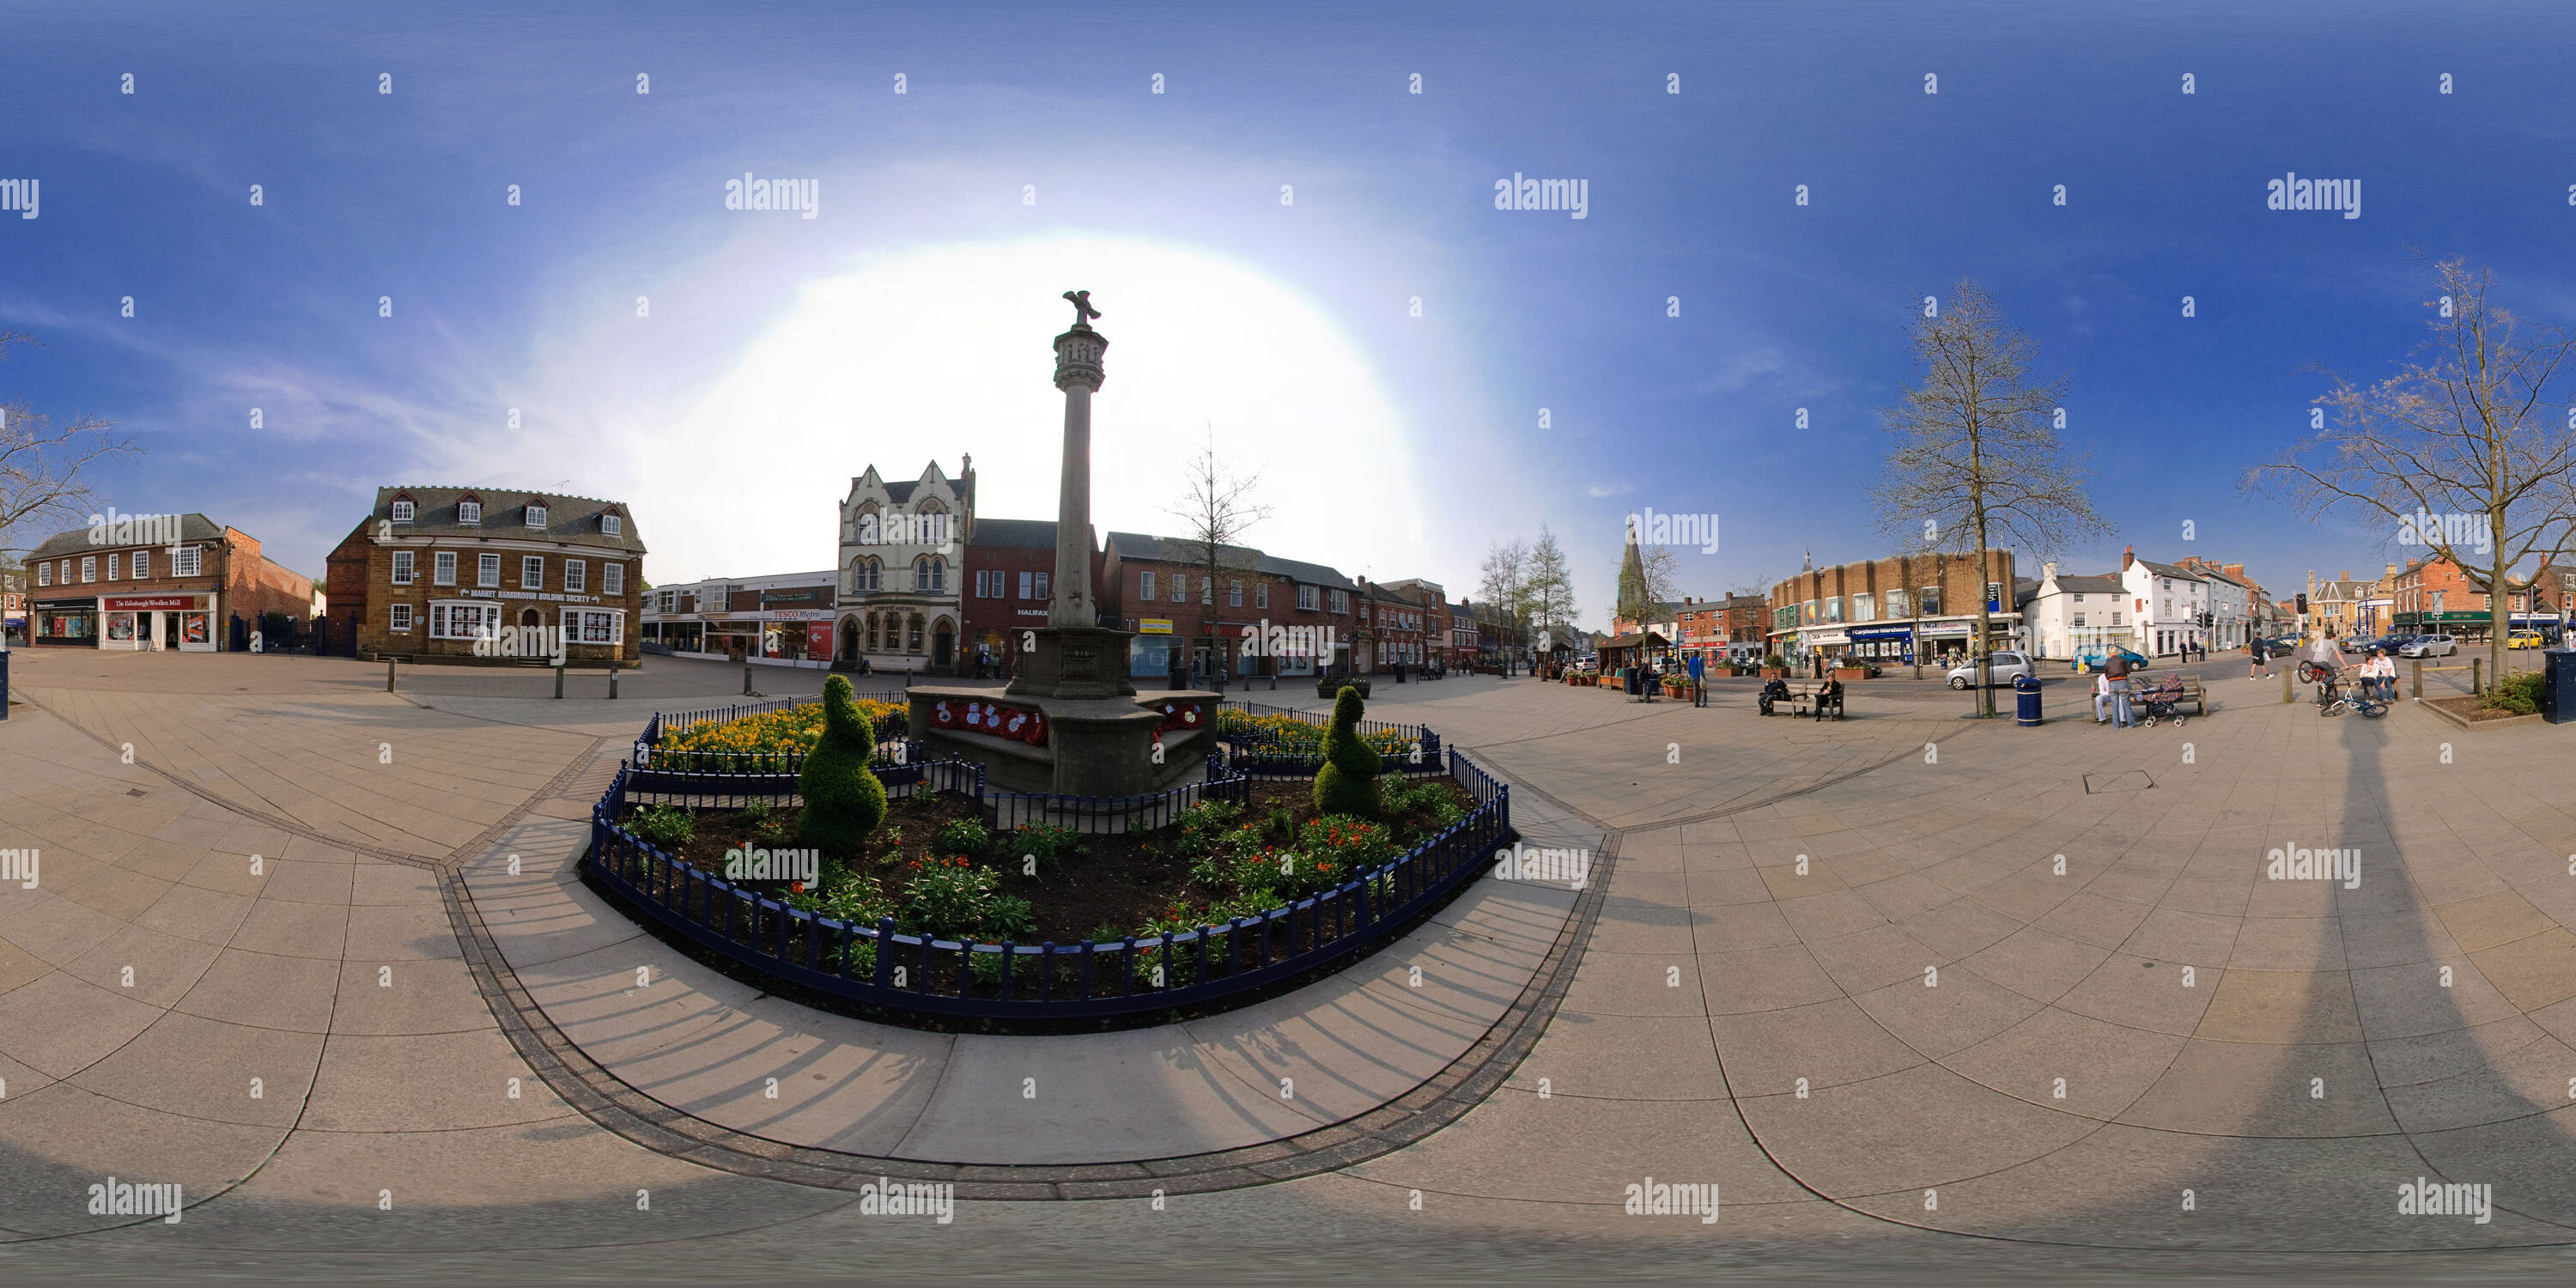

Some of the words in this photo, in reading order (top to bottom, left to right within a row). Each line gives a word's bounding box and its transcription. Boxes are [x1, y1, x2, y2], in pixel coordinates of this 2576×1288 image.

[471, 589, 496, 598] MARKET
[498, 591, 537, 600] HARBOROUGH
[538, 592, 564, 601] BUILDING
[566, 594, 590, 603] SOCIETY
